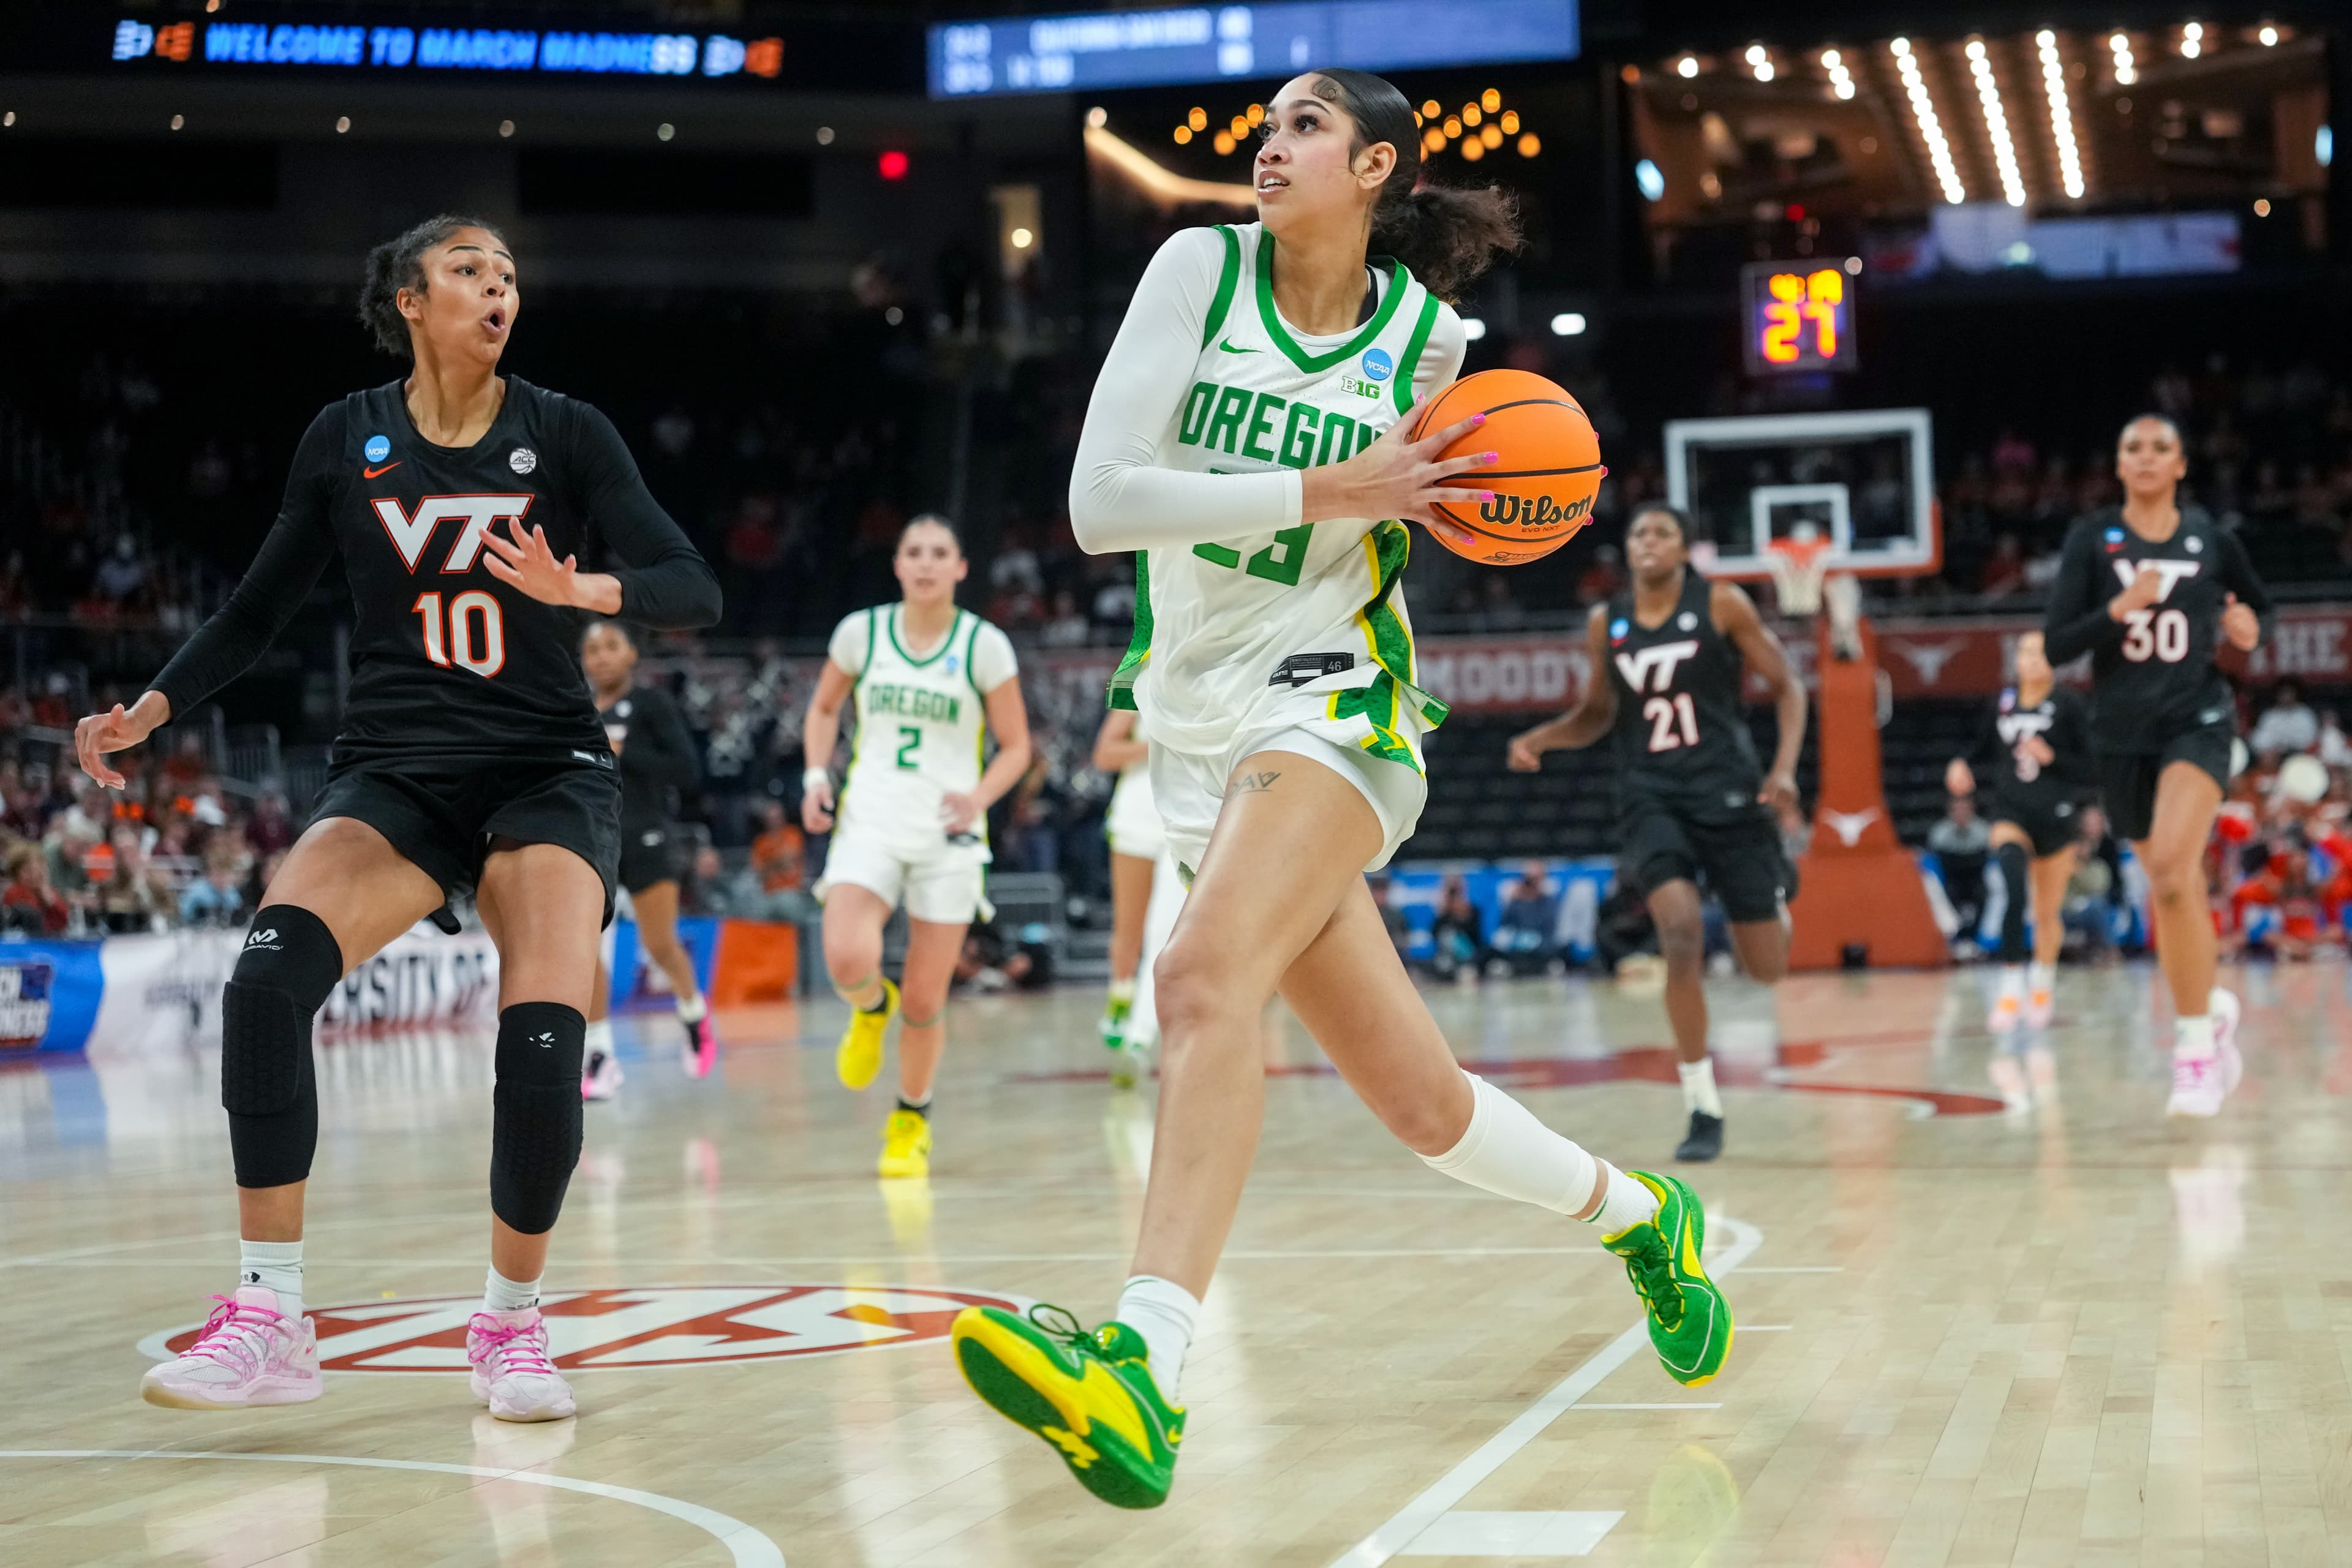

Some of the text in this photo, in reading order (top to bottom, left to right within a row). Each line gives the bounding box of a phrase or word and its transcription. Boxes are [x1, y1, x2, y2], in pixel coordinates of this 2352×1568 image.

[205, 22, 697, 75] WELCOME TO MARCH MADNESS
[1762, 302, 1837, 363] 27
[1366, 360, 1390, 375] NCAA
[370, 494, 535, 575] VT
[1480, 492, 1592, 526] Wilson
[412, 590, 505, 678] 10
[2122, 609, 2189, 663] 30
[1328, 661, 1341, 671] 46
[1615, 639, 1701, 693] VT
[869, 683, 962, 724] OREGON
[1643, 692, 1700, 753] 21
[897, 726, 922, 770] 2
